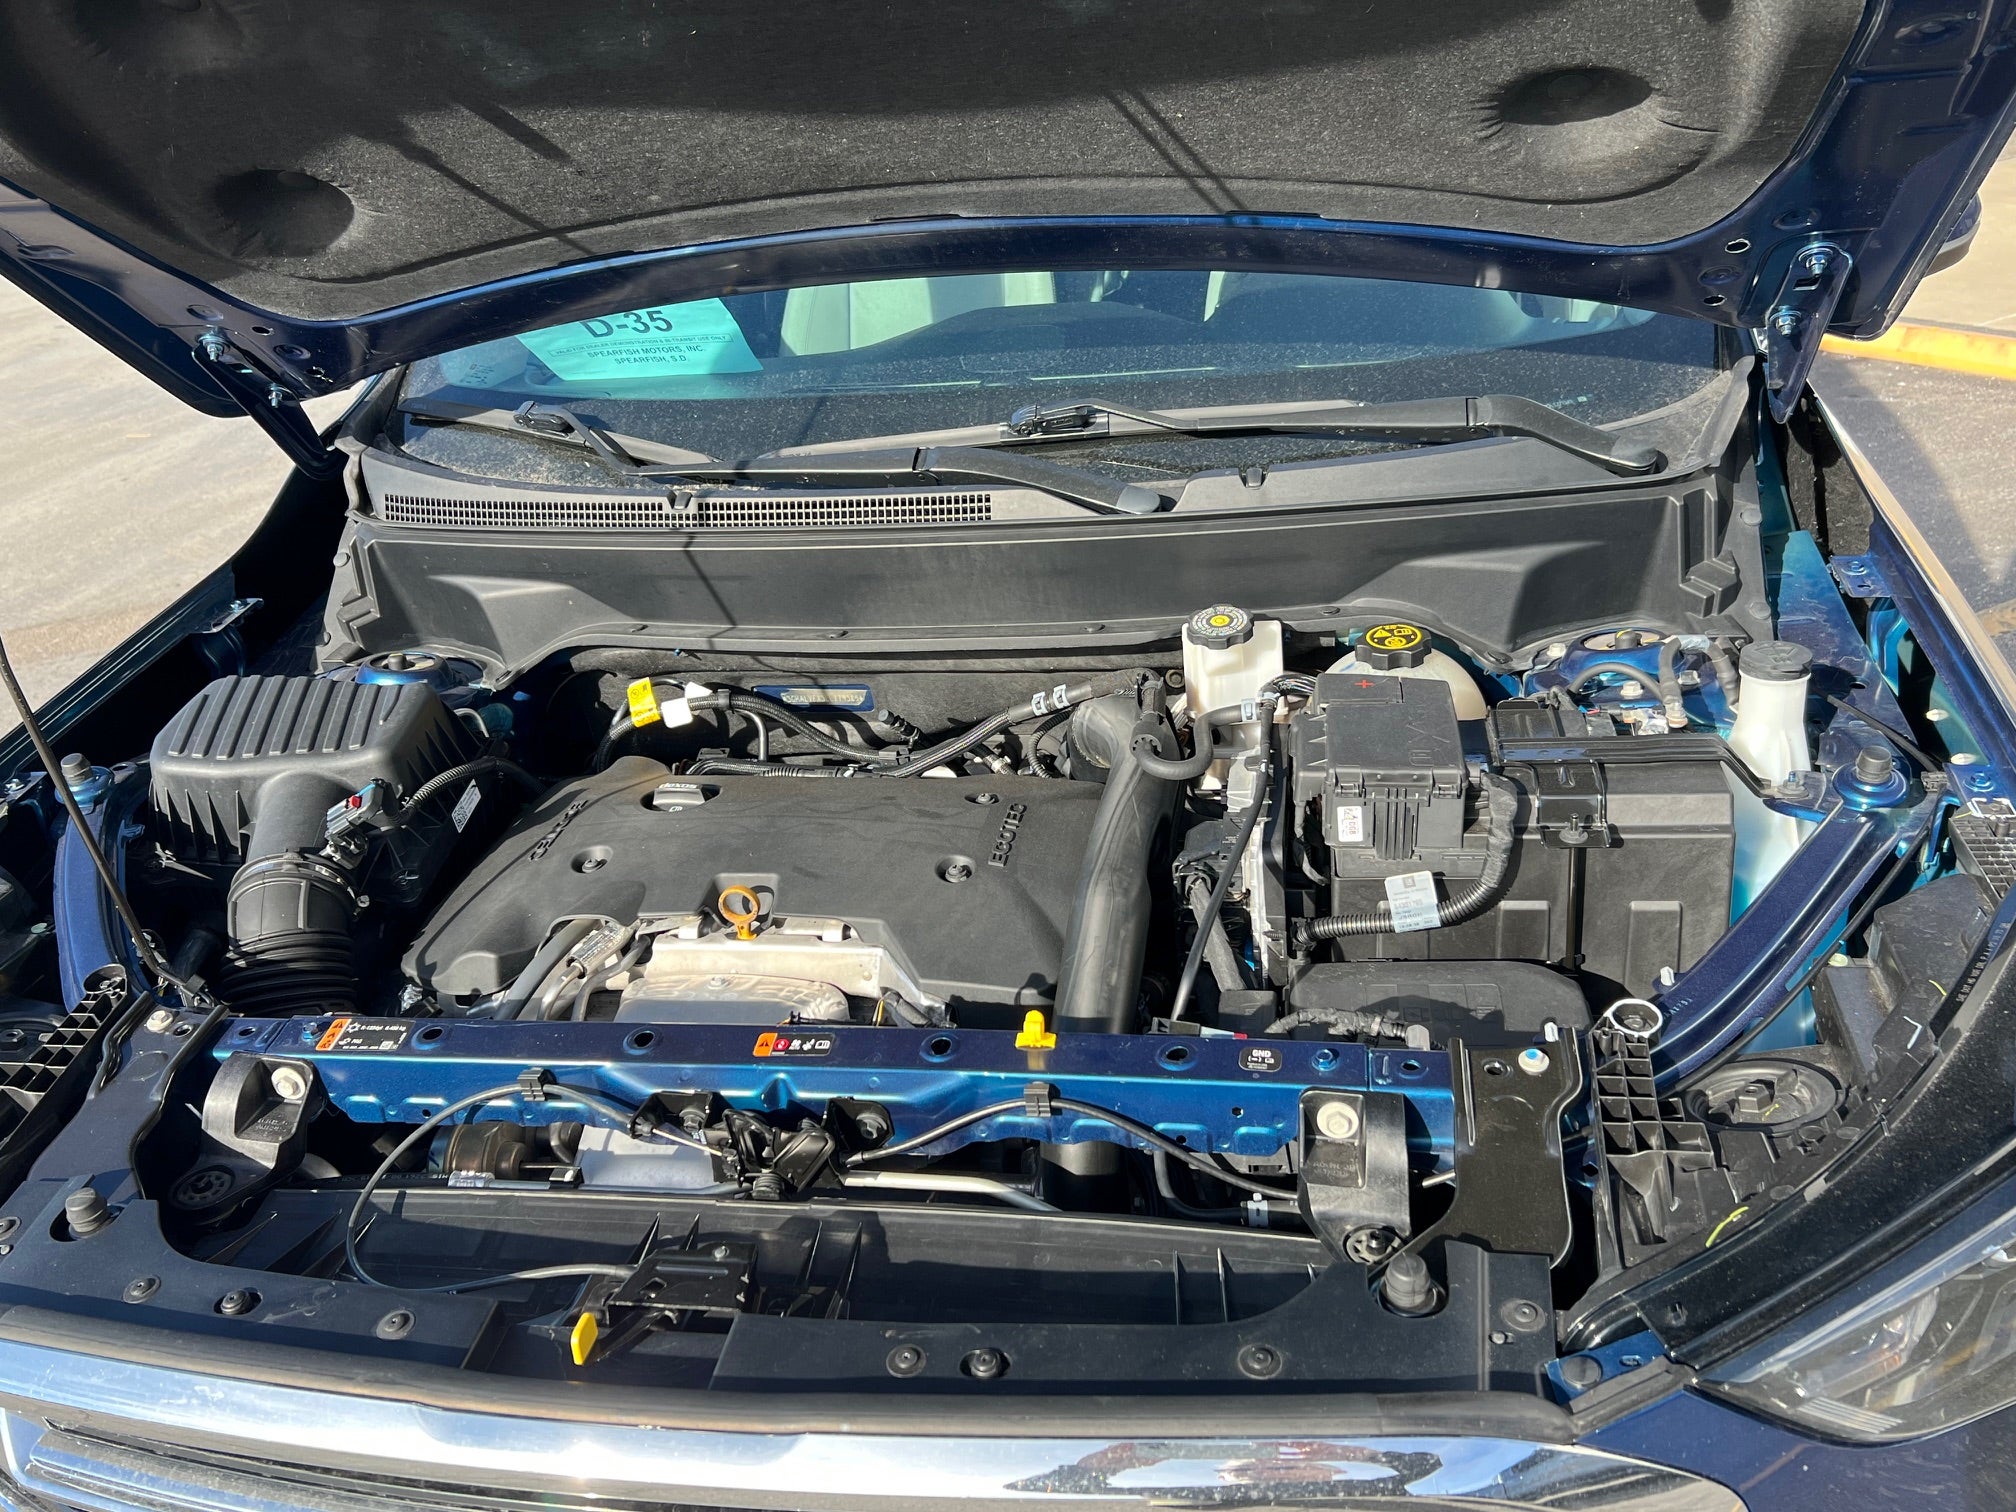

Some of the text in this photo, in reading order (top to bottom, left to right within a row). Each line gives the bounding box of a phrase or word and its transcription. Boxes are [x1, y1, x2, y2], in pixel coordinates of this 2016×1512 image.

[580, 310, 673, 338] D-35
[587, 348, 640, 358] SPEARFISH
[615, 356, 670, 365] SPEARFISH,
[988, 803, 1027, 867] ECOTEC
[1252, 1049, 1272, 1058] GND
